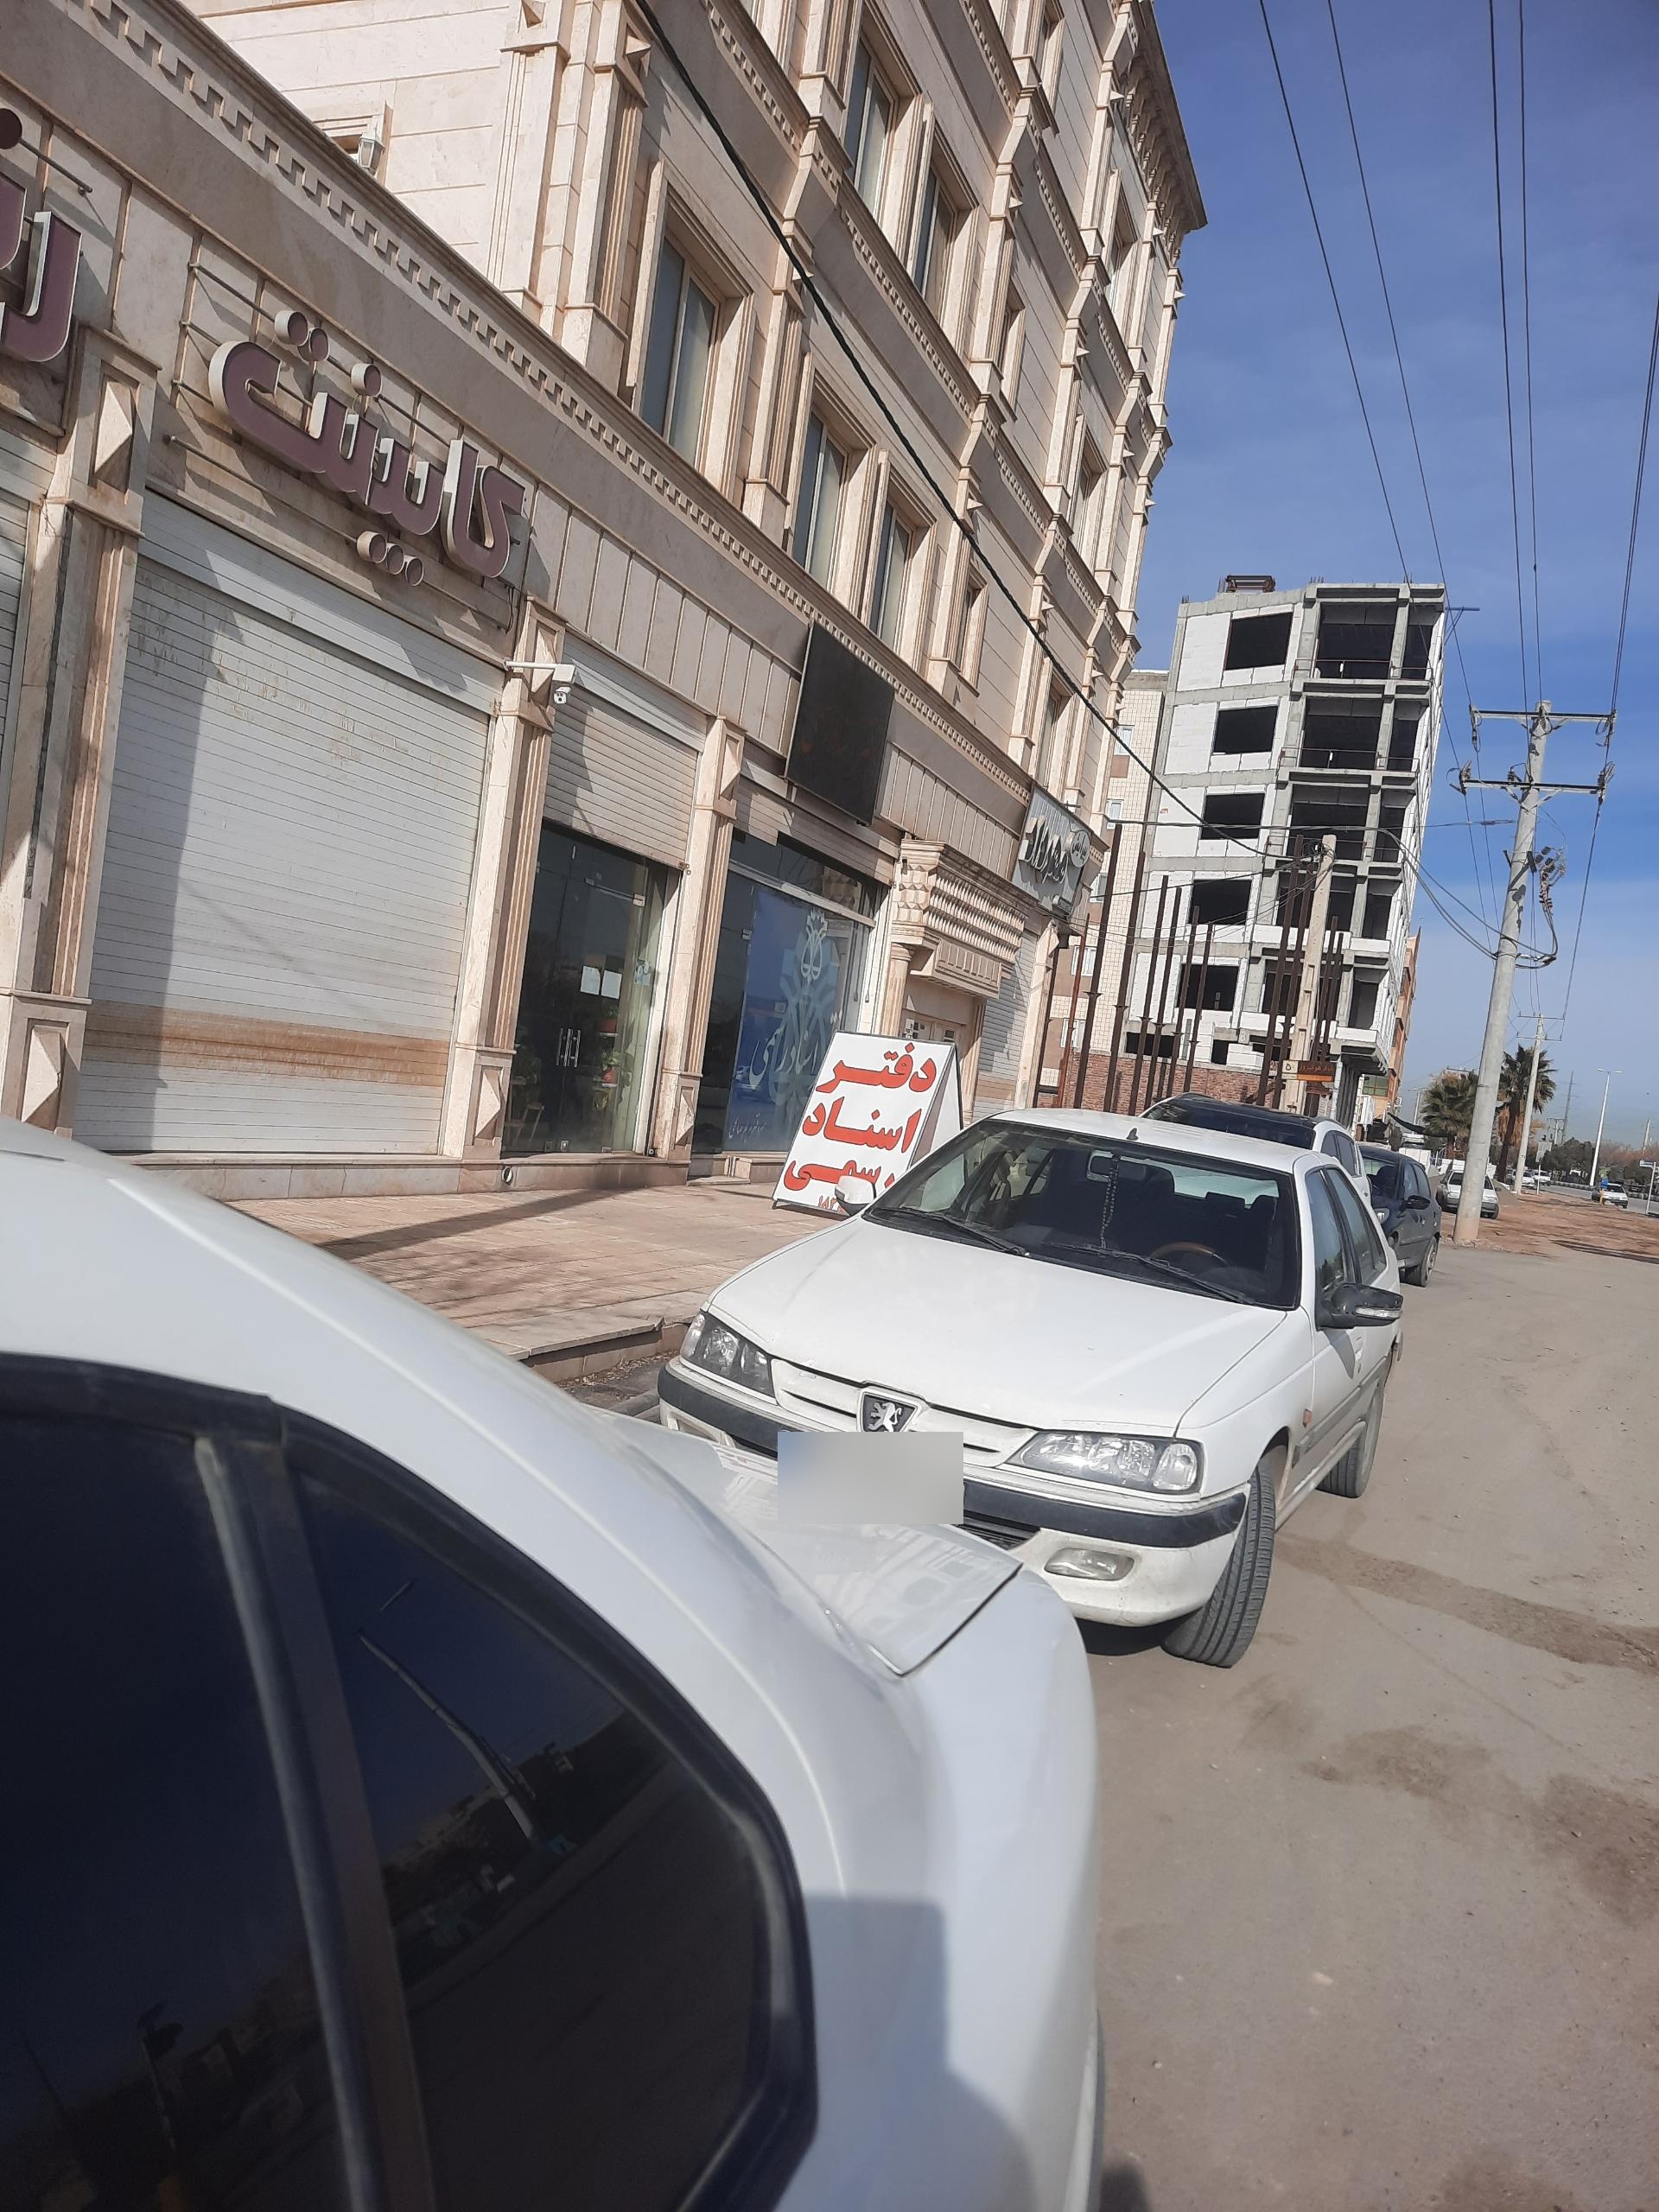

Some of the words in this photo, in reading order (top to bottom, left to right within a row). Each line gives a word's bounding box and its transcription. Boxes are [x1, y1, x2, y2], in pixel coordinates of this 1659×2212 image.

[208, 309, 525, 586] کابینت
[815, 1042, 937, 1094] دفتر
[803, 1096, 922, 1154] اسناد
